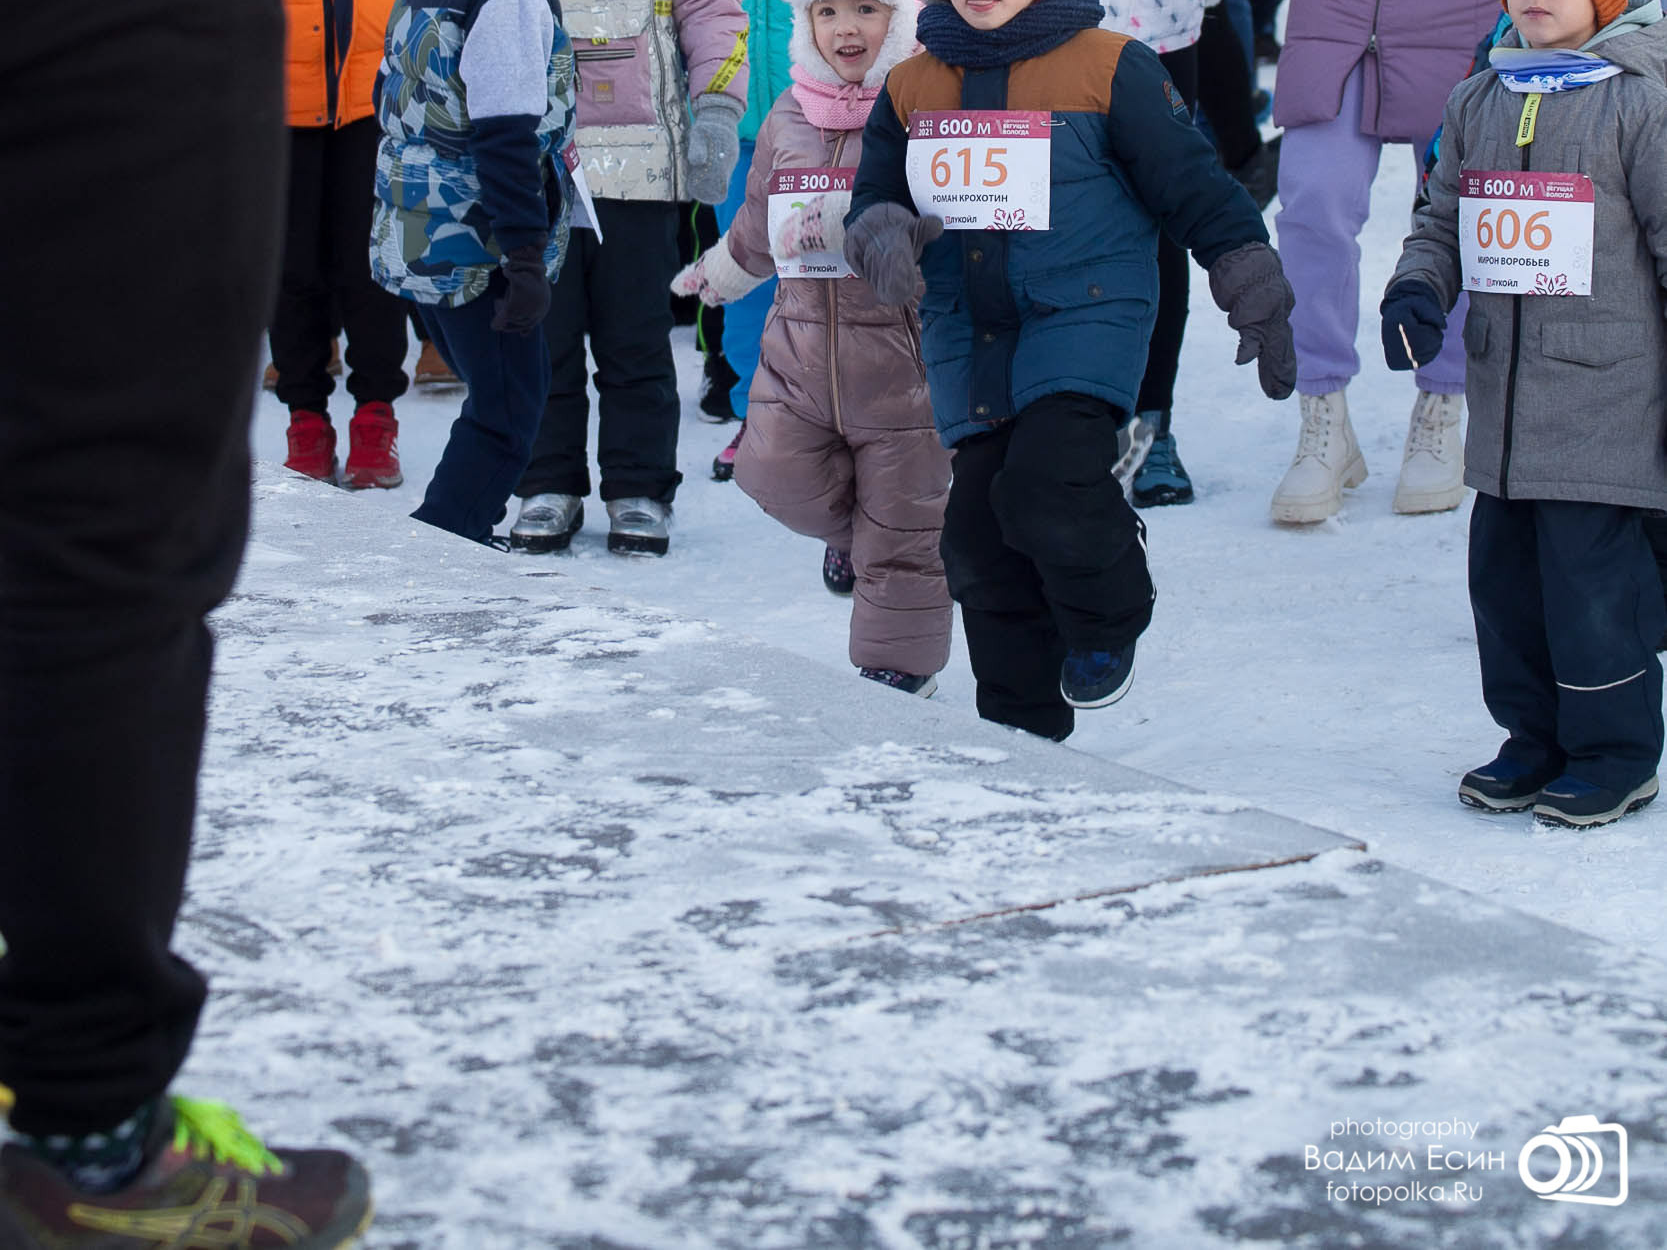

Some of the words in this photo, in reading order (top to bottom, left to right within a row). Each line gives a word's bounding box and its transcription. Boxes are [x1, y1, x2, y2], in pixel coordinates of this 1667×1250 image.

[939, 118, 973, 136] 600
[931, 147, 1008, 188] 615
[778, 183, 794, 191] 2021
[799, 174, 830, 190] 300
[1484, 179, 1515, 196] 600
[932, 194, 958, 203] РОМАН
[959, 194, 1008, 203] КРОХОТИН
[1476, 208, 1552, 251] 606
[1477, 255, 1499, 265] МИРОН
[1500, 257, 1550, 267] ВОРОБЬЕВ
